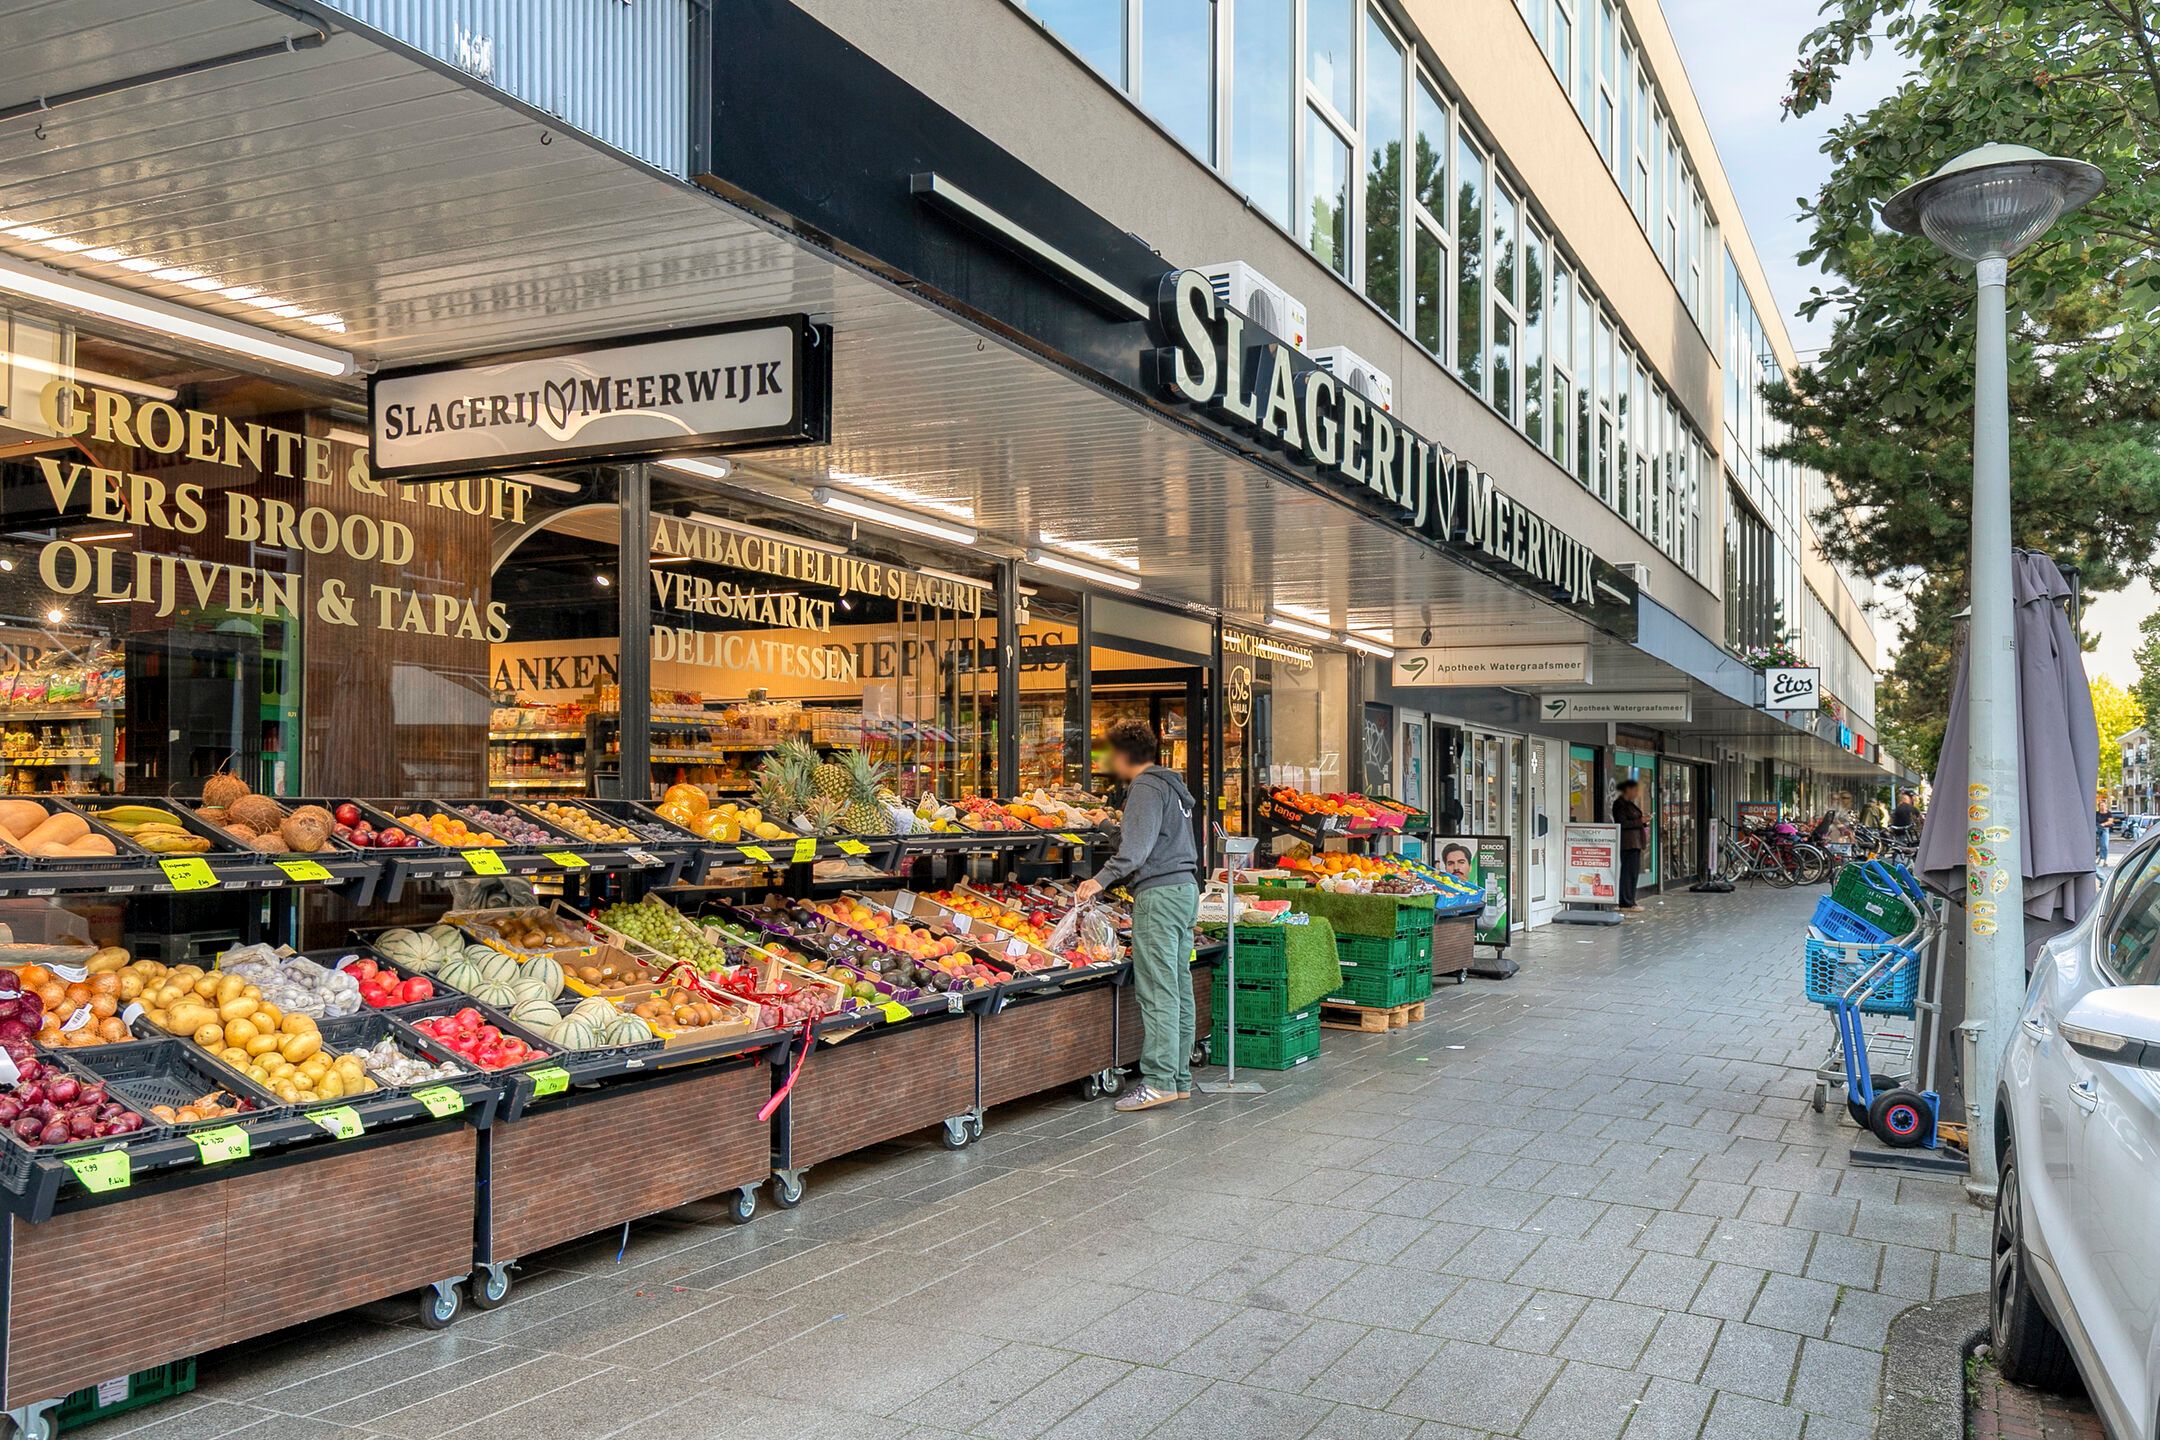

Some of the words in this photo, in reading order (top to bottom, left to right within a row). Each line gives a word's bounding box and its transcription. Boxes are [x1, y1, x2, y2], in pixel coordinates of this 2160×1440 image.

[385, 390, 541, 440] SLAGERIJ
[580, 360, 783, 417] MEERWIJK
[39, 380, 333, 485] GROENTE
[348, 448, 388, 497] &
[1174, 269, 1431, 528] SLAGERIJ
[1465, 465, 1595, 606] MEERWIJK
[34, 456, 207, 534] VERS
[225, 491, 415, 566] BROOD
[38, 541, 302, 620] OLIJVEN
[316, 578, 359, 627] &
[371, 584, 510, 644] TAPAS
[650, 516, 883, 598] AMBACHTELIJKE
[886, 570, 983, 622] SLAGERIJ
[650, 569, 835, 634] VERSMARKT
[652, 624, 860, 684] DELICATESSEN
[1437, 660, 1487, 673] Apotheek
[1490, 660, 1582, 672] Watergraafsmeer
[1772, 673, 1814, 695] Etos
[1572, 703, 1611, 714] Apotheek
[1613, 703, 1684, 713] Watergraafsmeer
[1274, 803, 1302, 822] tango
